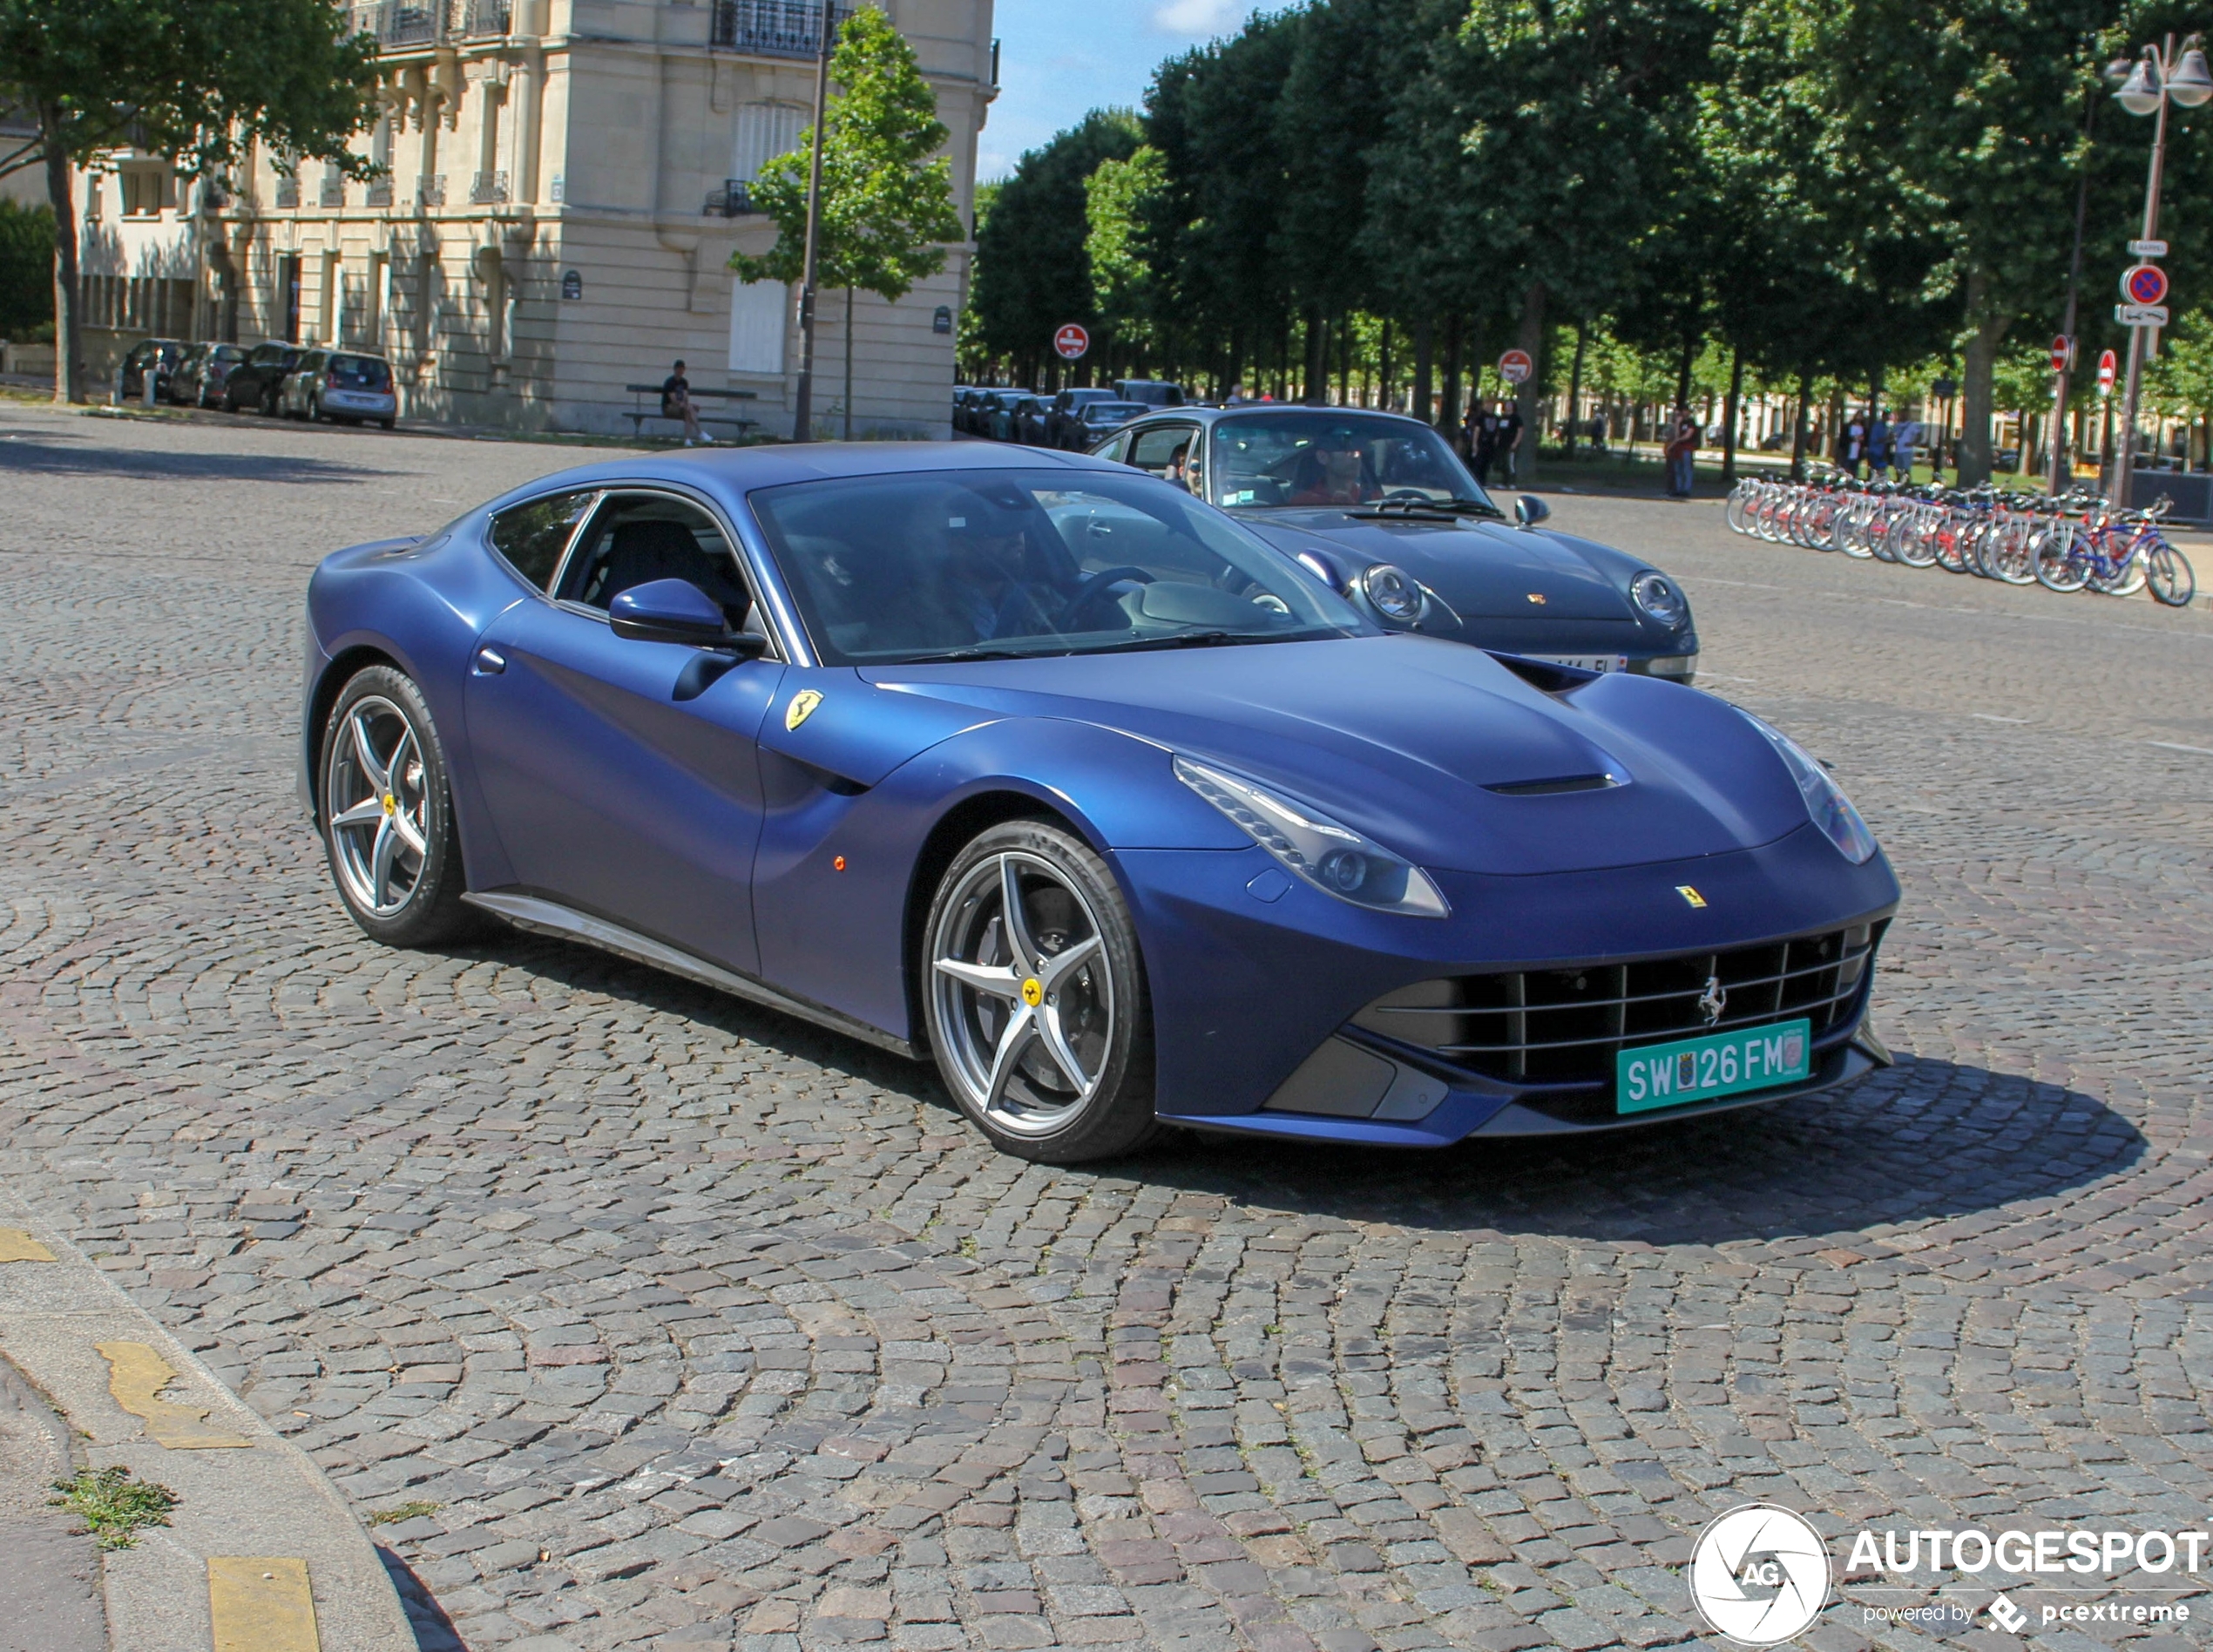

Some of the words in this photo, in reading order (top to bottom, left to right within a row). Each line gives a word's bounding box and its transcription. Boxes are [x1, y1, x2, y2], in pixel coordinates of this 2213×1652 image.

[1628, 1055, 1673, 1100] SW
[1701, 1045, 1738, 1088] 26
[1745, 1035, 1783, 1080] FM
